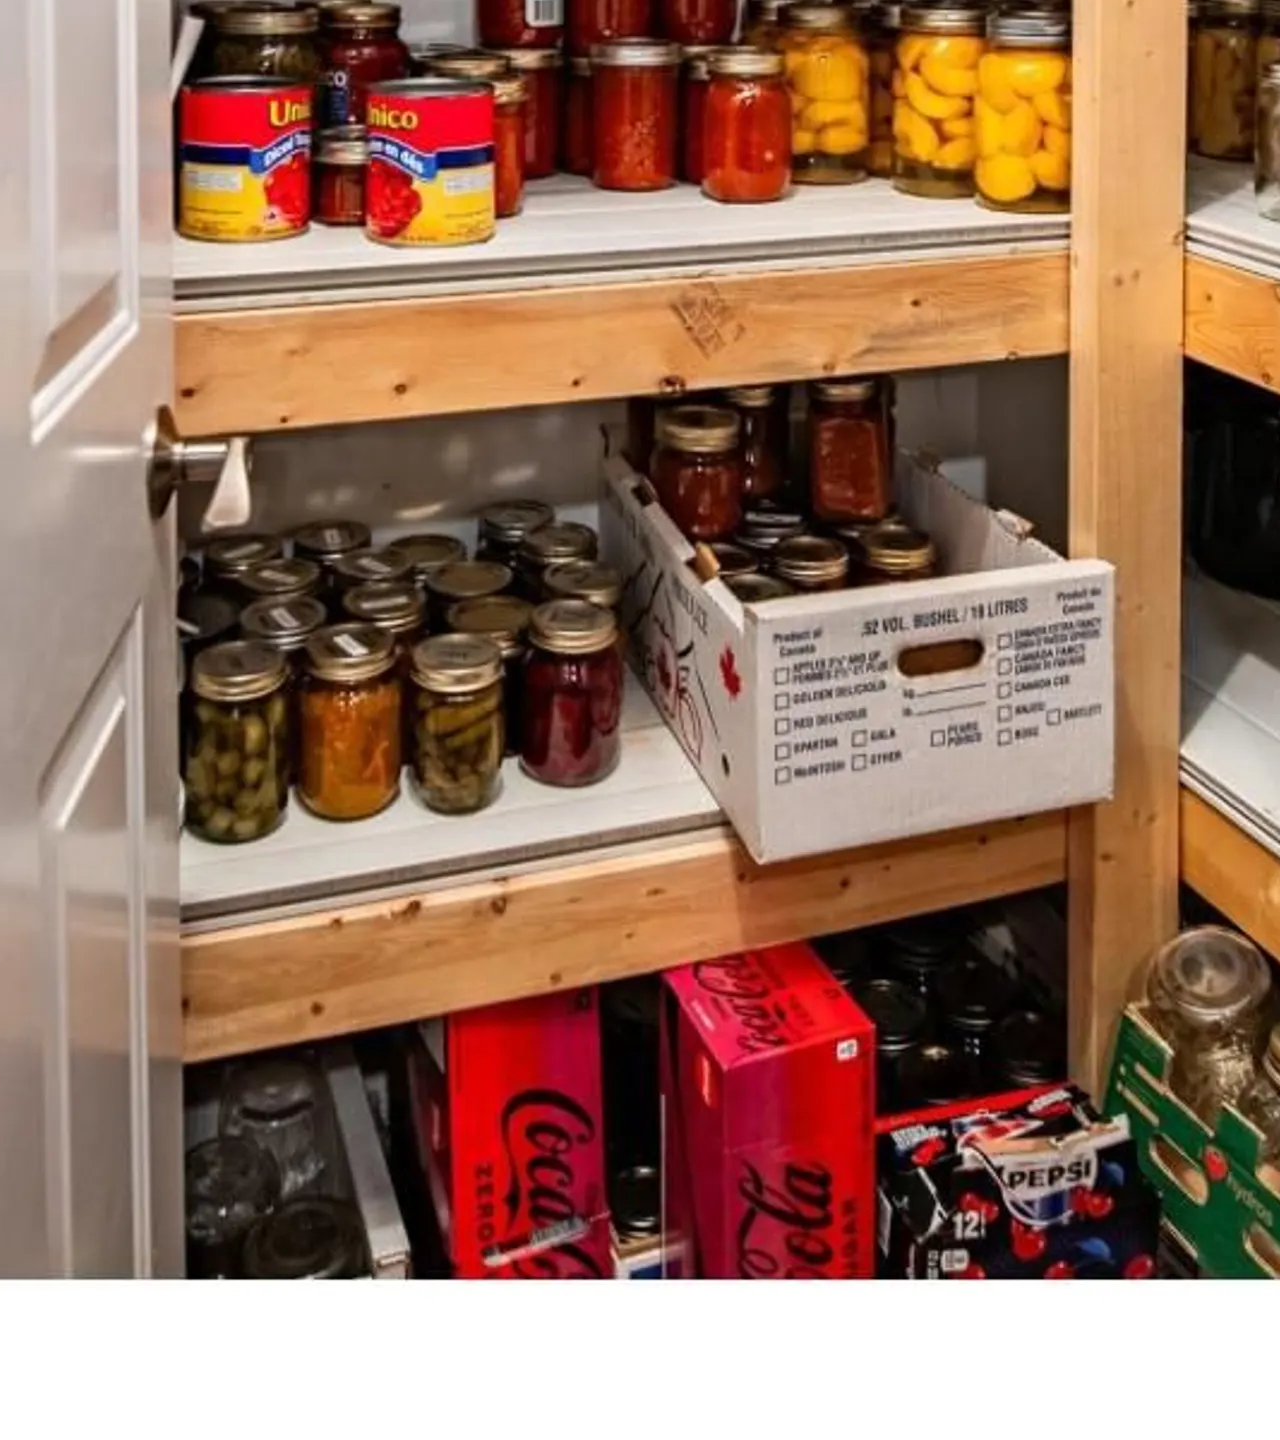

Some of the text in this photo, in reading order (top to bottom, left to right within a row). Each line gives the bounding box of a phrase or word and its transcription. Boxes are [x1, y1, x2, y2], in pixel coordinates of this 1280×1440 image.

[270, 100, 311, 127] Uni
[370, 104, 418, 130] nico
[987, 596, 1029, 618] LITRES
[1008, 1160, 1092, 1191] PEPSI
[475, 1162, 496, 1242] ZERO
